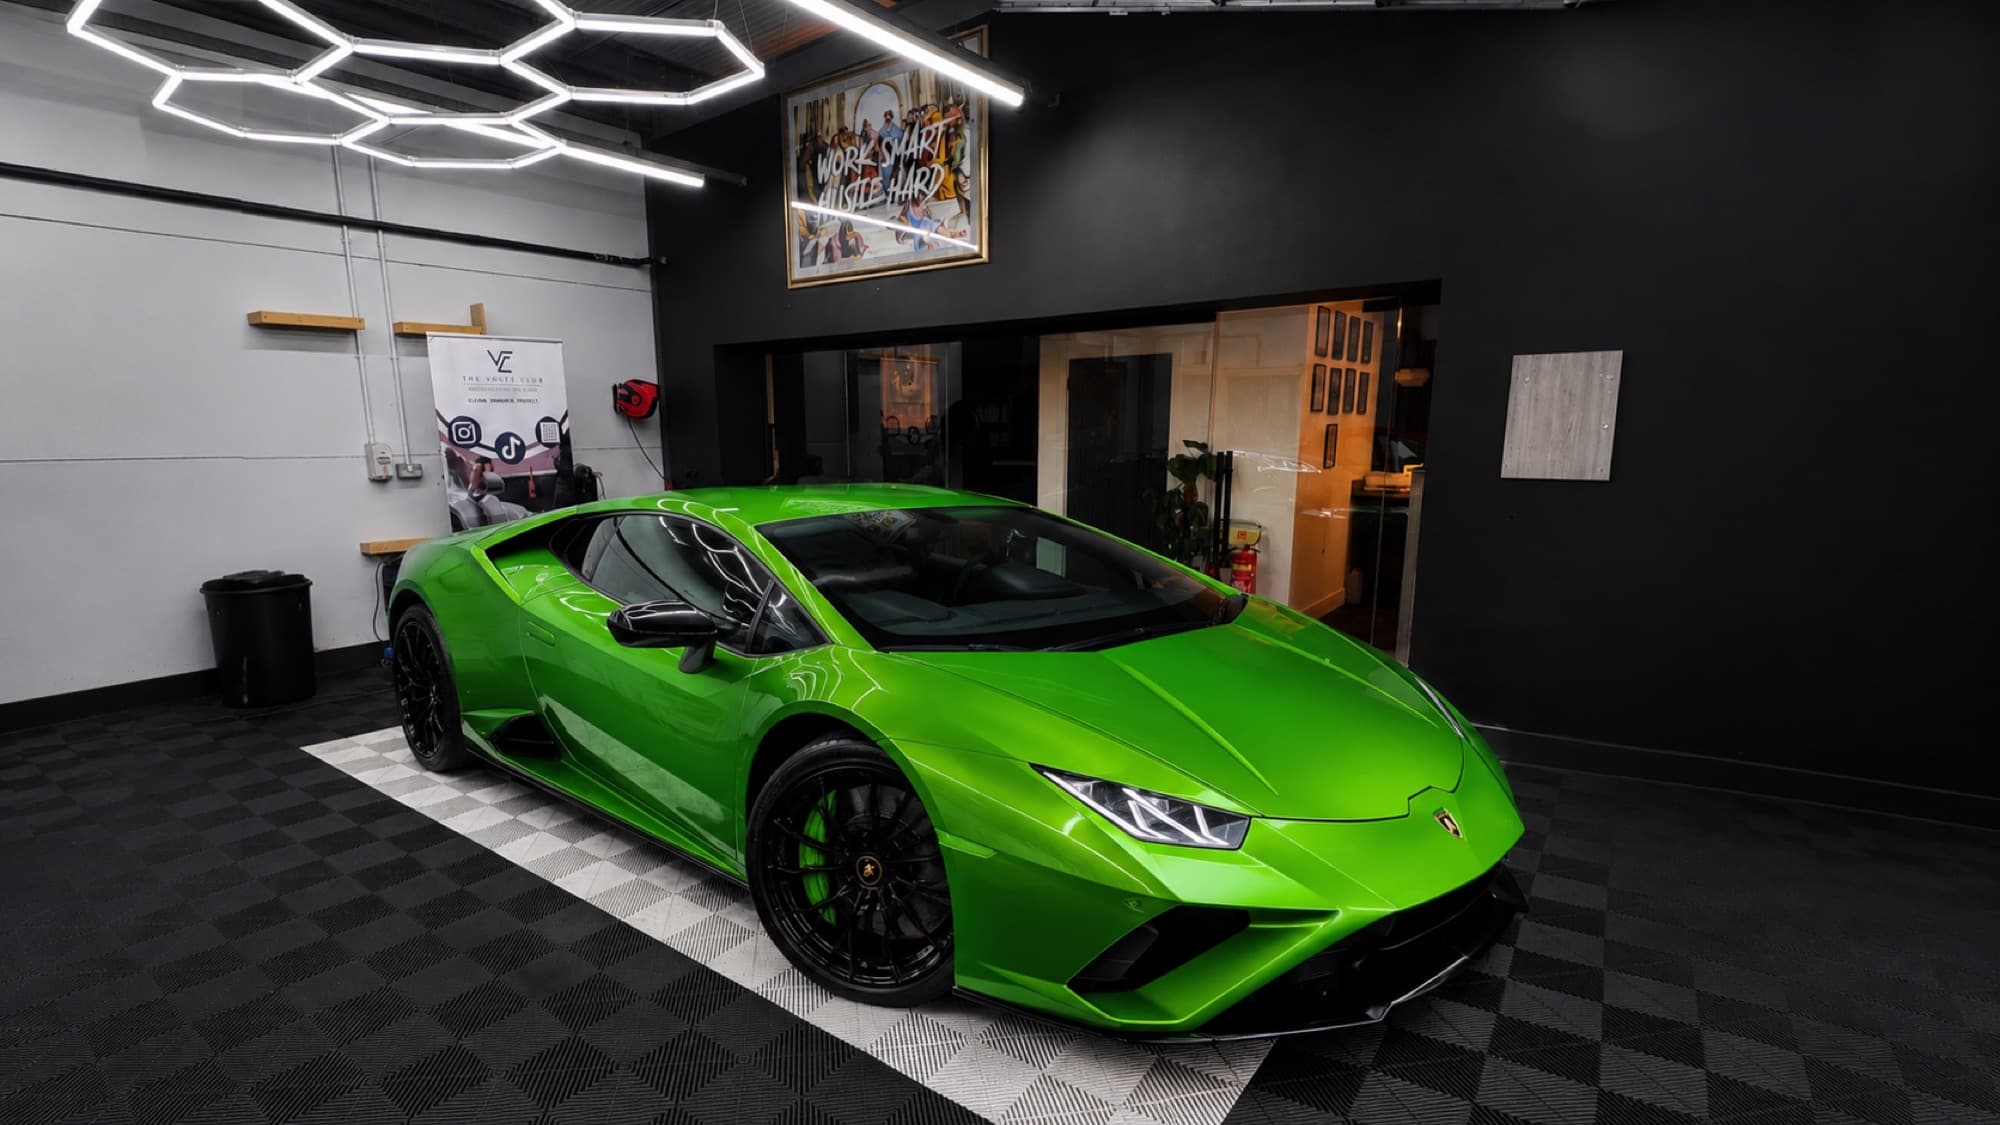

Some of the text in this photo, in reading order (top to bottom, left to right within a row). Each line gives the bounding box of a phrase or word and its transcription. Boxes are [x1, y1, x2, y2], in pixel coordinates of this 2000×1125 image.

[817, 114, 962, 184] WORK SMART
[816, 161, 945, 227] HUSTLE HARD
